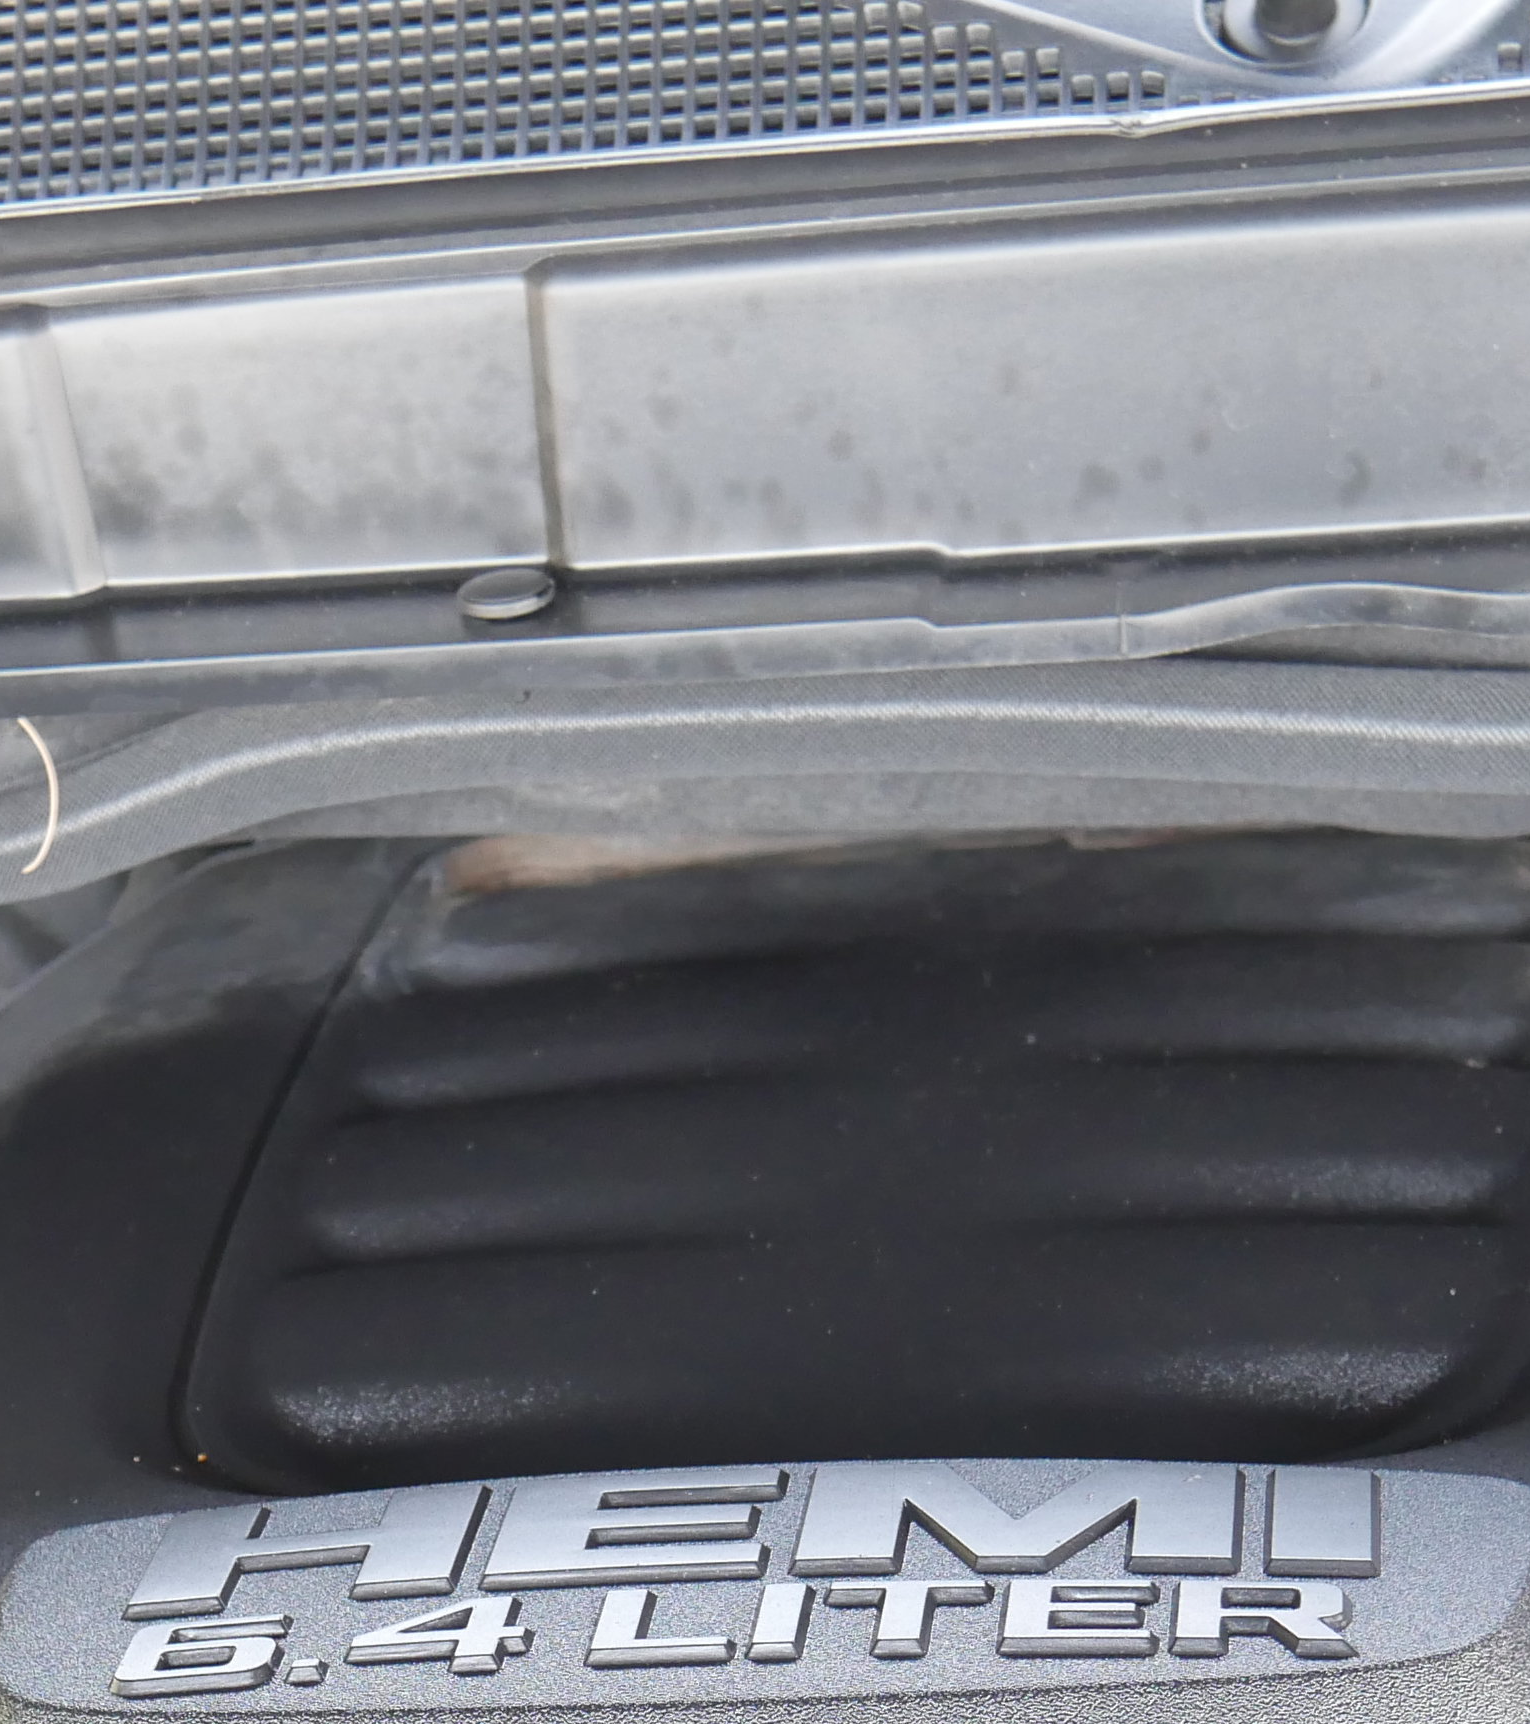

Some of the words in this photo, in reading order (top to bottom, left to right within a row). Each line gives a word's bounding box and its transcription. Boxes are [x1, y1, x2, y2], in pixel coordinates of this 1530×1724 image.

[123, 1459, 1383, 1618] HEMI
[110, 1595, 535, 1697] 6.4
[586, 1578, 1359, 1670] LITER
